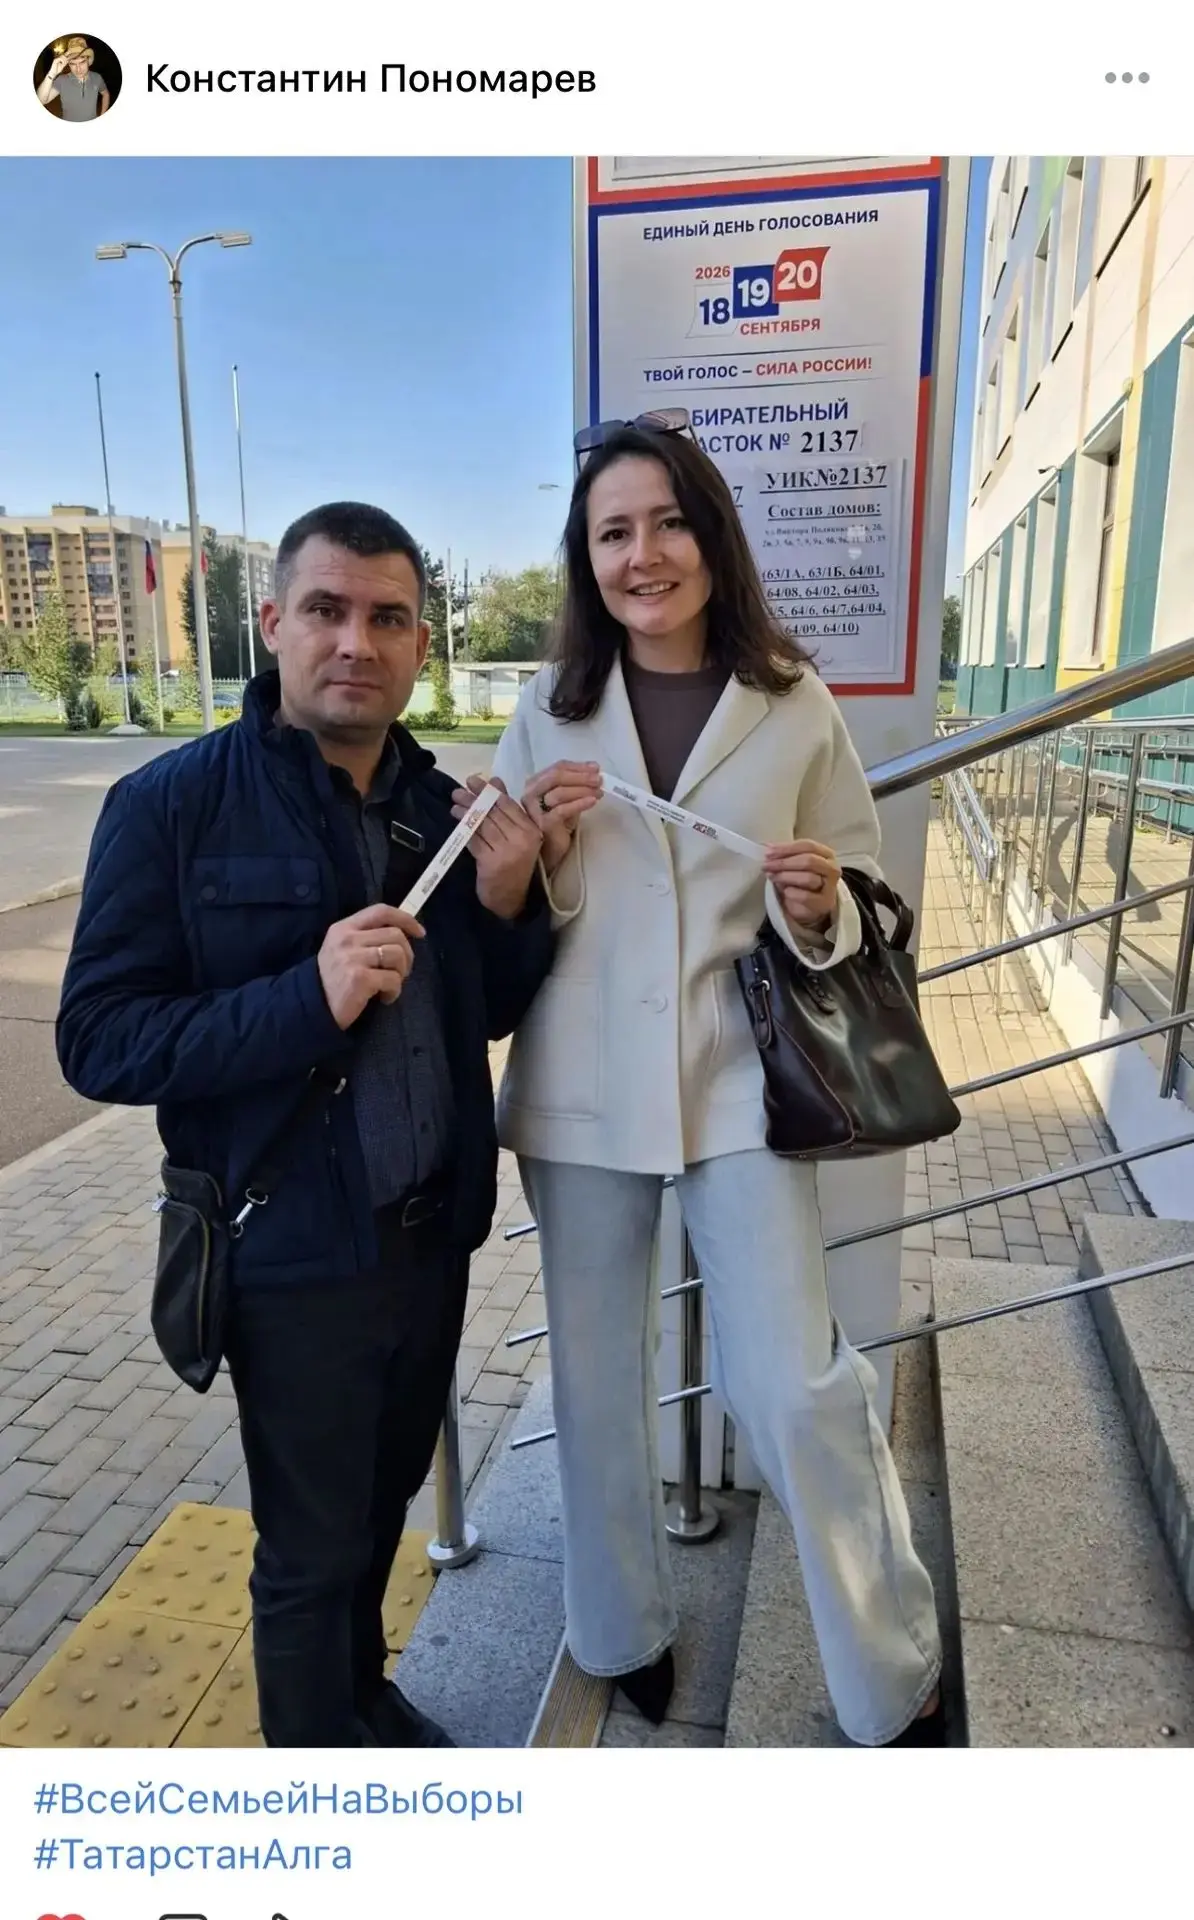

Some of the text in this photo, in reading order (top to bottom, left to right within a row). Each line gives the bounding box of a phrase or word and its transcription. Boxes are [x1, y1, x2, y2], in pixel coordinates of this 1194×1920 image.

[643, 209, 879, 242] ЕДИНЫЙ ДЕНЬ ГОЛОСОВАНИЯ
[695, 265, 731, 280] 2026
[699, 259, 818, 325] 18 19 20
[740, 318, 821, 336] СЕНТЯБРЯ
[643, 365, 684, 383] ТВОЙ
[688, 364, 738, 381] ГОЛОС
[756, 362, 798, 377] СИЛА
[803, 357, 873, 374] РОССИИ!
[692, 398, 849, 427] БИРАТЕЛЬНЫЙ
[698, 430, 858, 453] АСТОК № 2137
[766, 465, 887, 489] УИК№2137
[768, 503, 881, 518] Состав домов:
[849, 565, 885, 577] 64/01,
[805, 585, 840, 597] 64/02,
[844, 584, 879, 596] 64/03,
[791, 604, 818, 616] 64/6,
[823, 621, 860, 634] 64/10)
